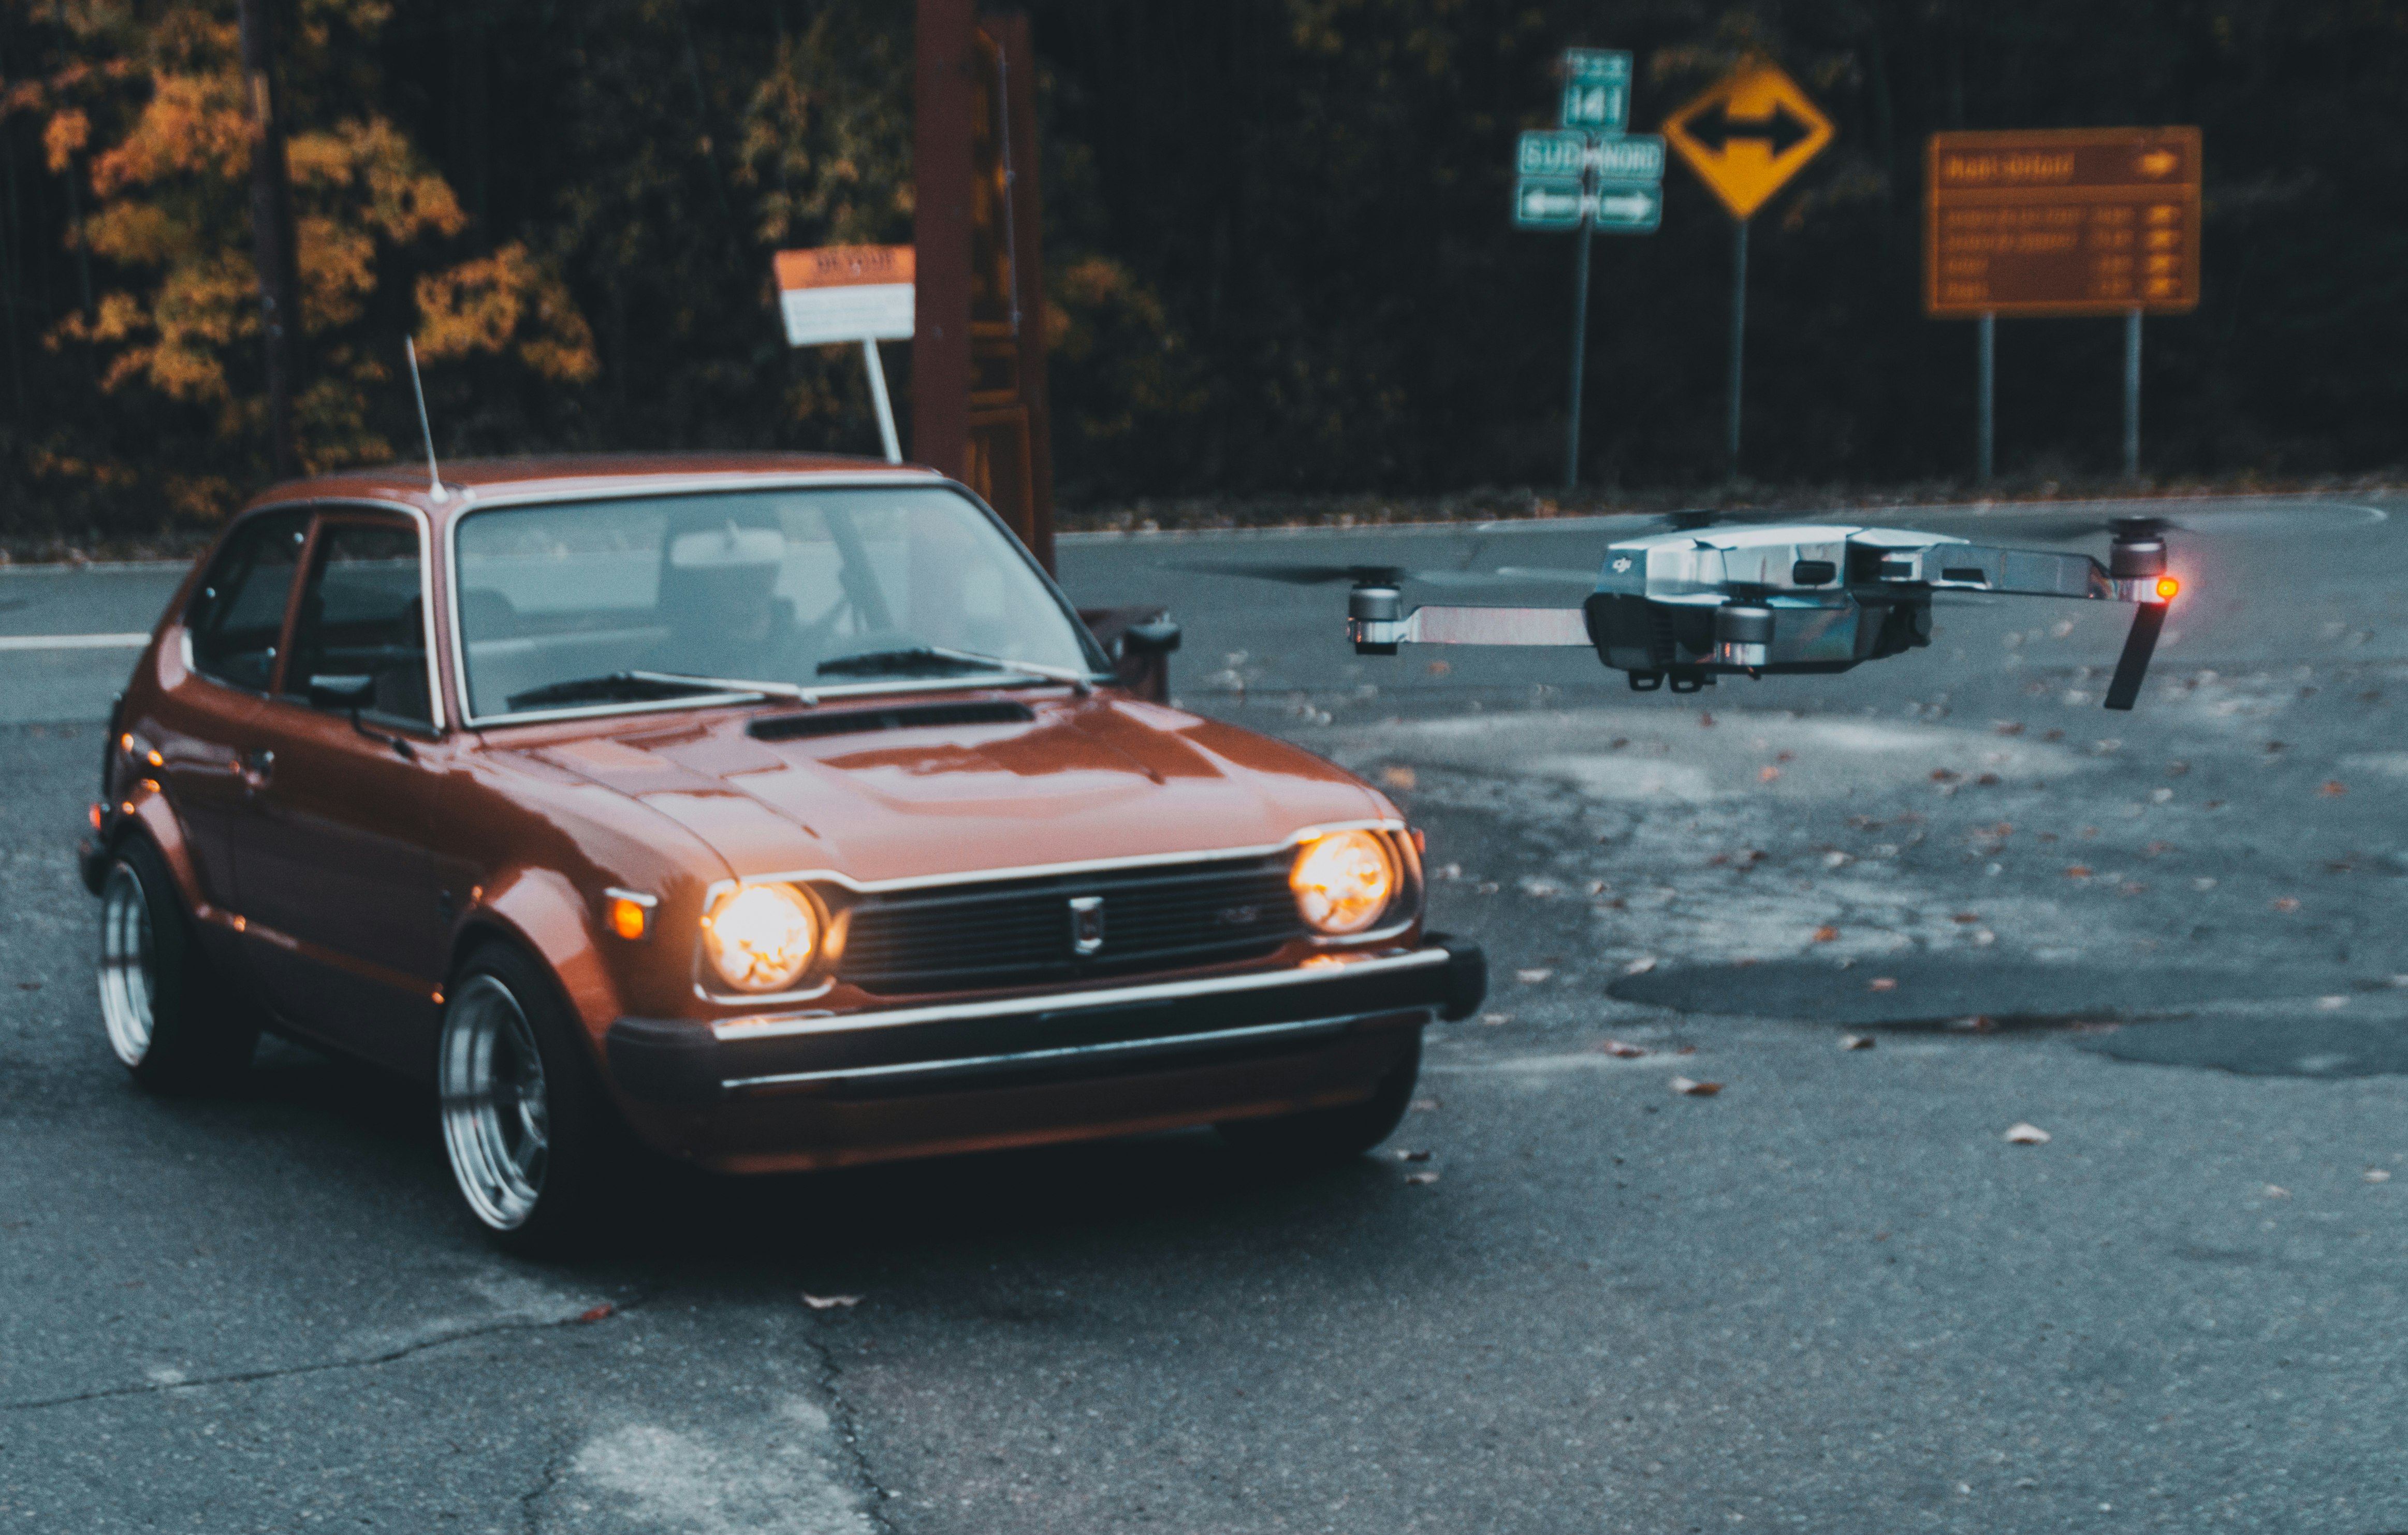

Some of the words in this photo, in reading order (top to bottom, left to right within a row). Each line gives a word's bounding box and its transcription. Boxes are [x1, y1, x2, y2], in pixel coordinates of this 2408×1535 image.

[1570, 86, 1622, 124] 141
[1526, 138, 1581, 165] SUD
[1605, 140, 1660, 169] NORD
